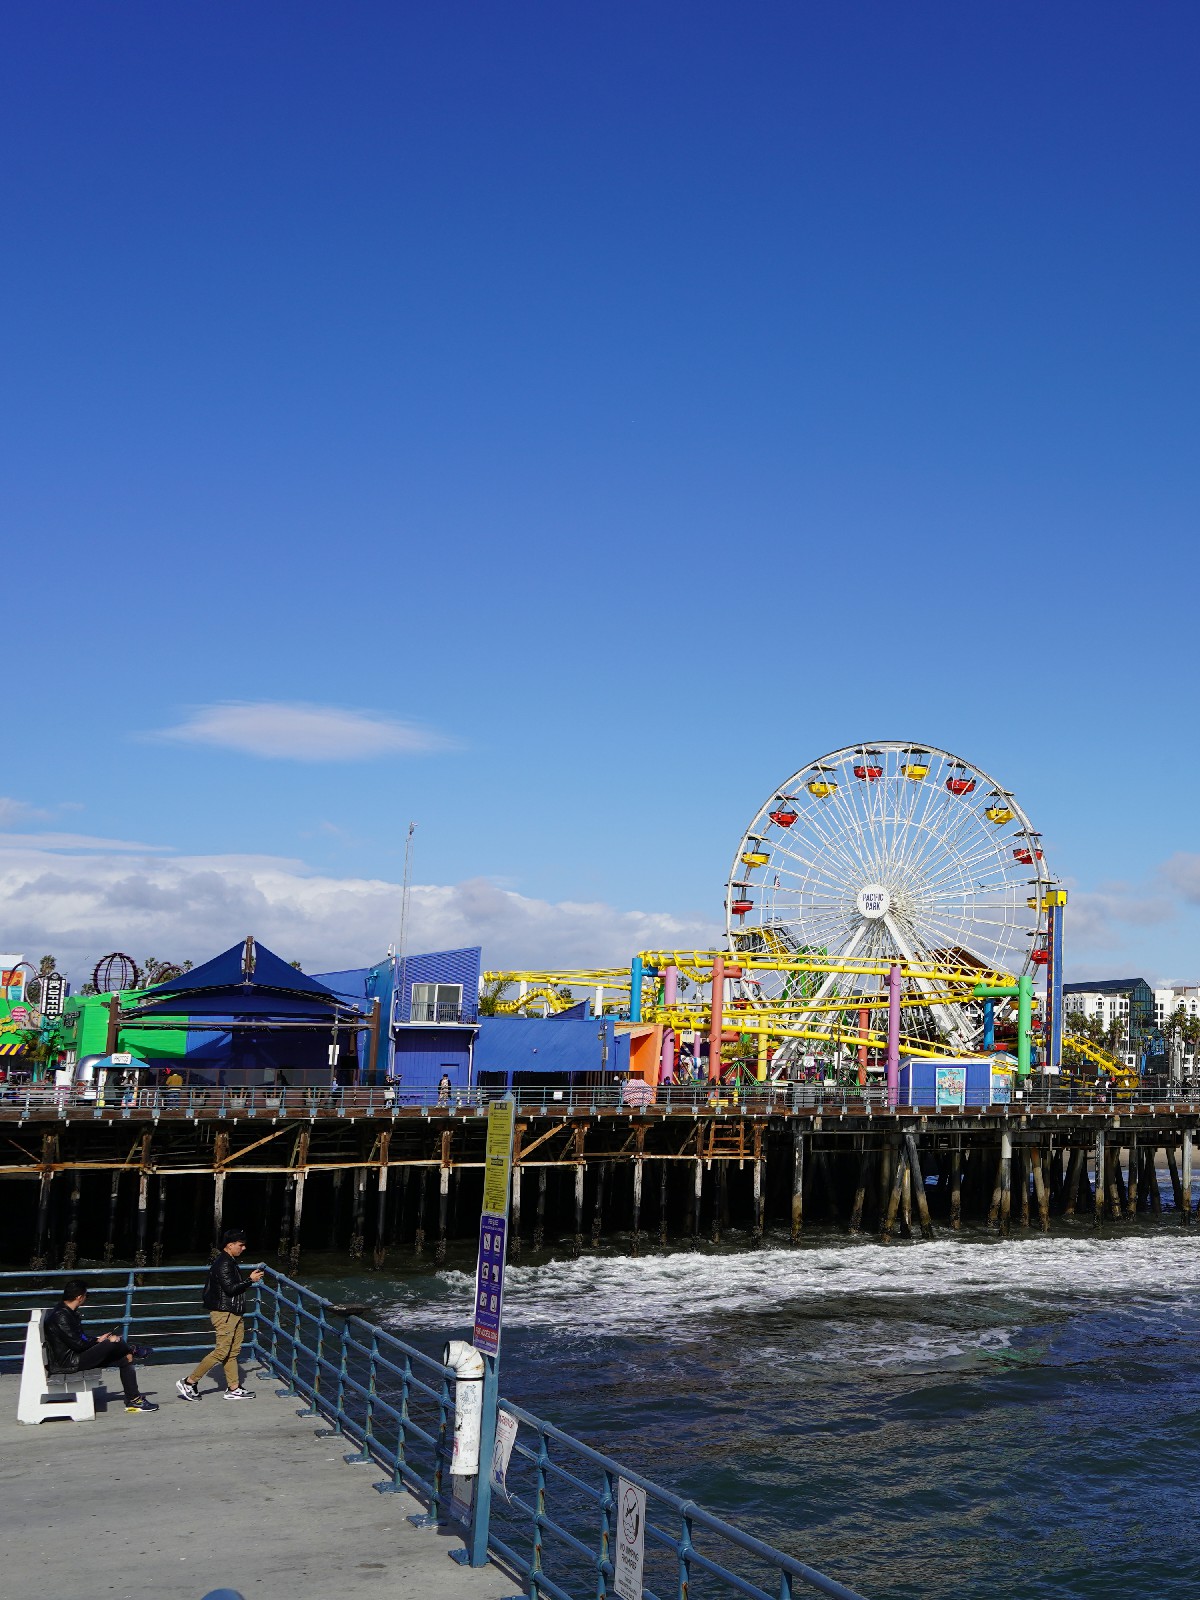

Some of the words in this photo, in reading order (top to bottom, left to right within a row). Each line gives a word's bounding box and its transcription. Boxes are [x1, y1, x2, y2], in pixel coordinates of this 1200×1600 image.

[862, 893, 884, 901] PACIFIC
[865, 902, 881, 911] PARK
[46, 984, 60, 1015] COFFEE
